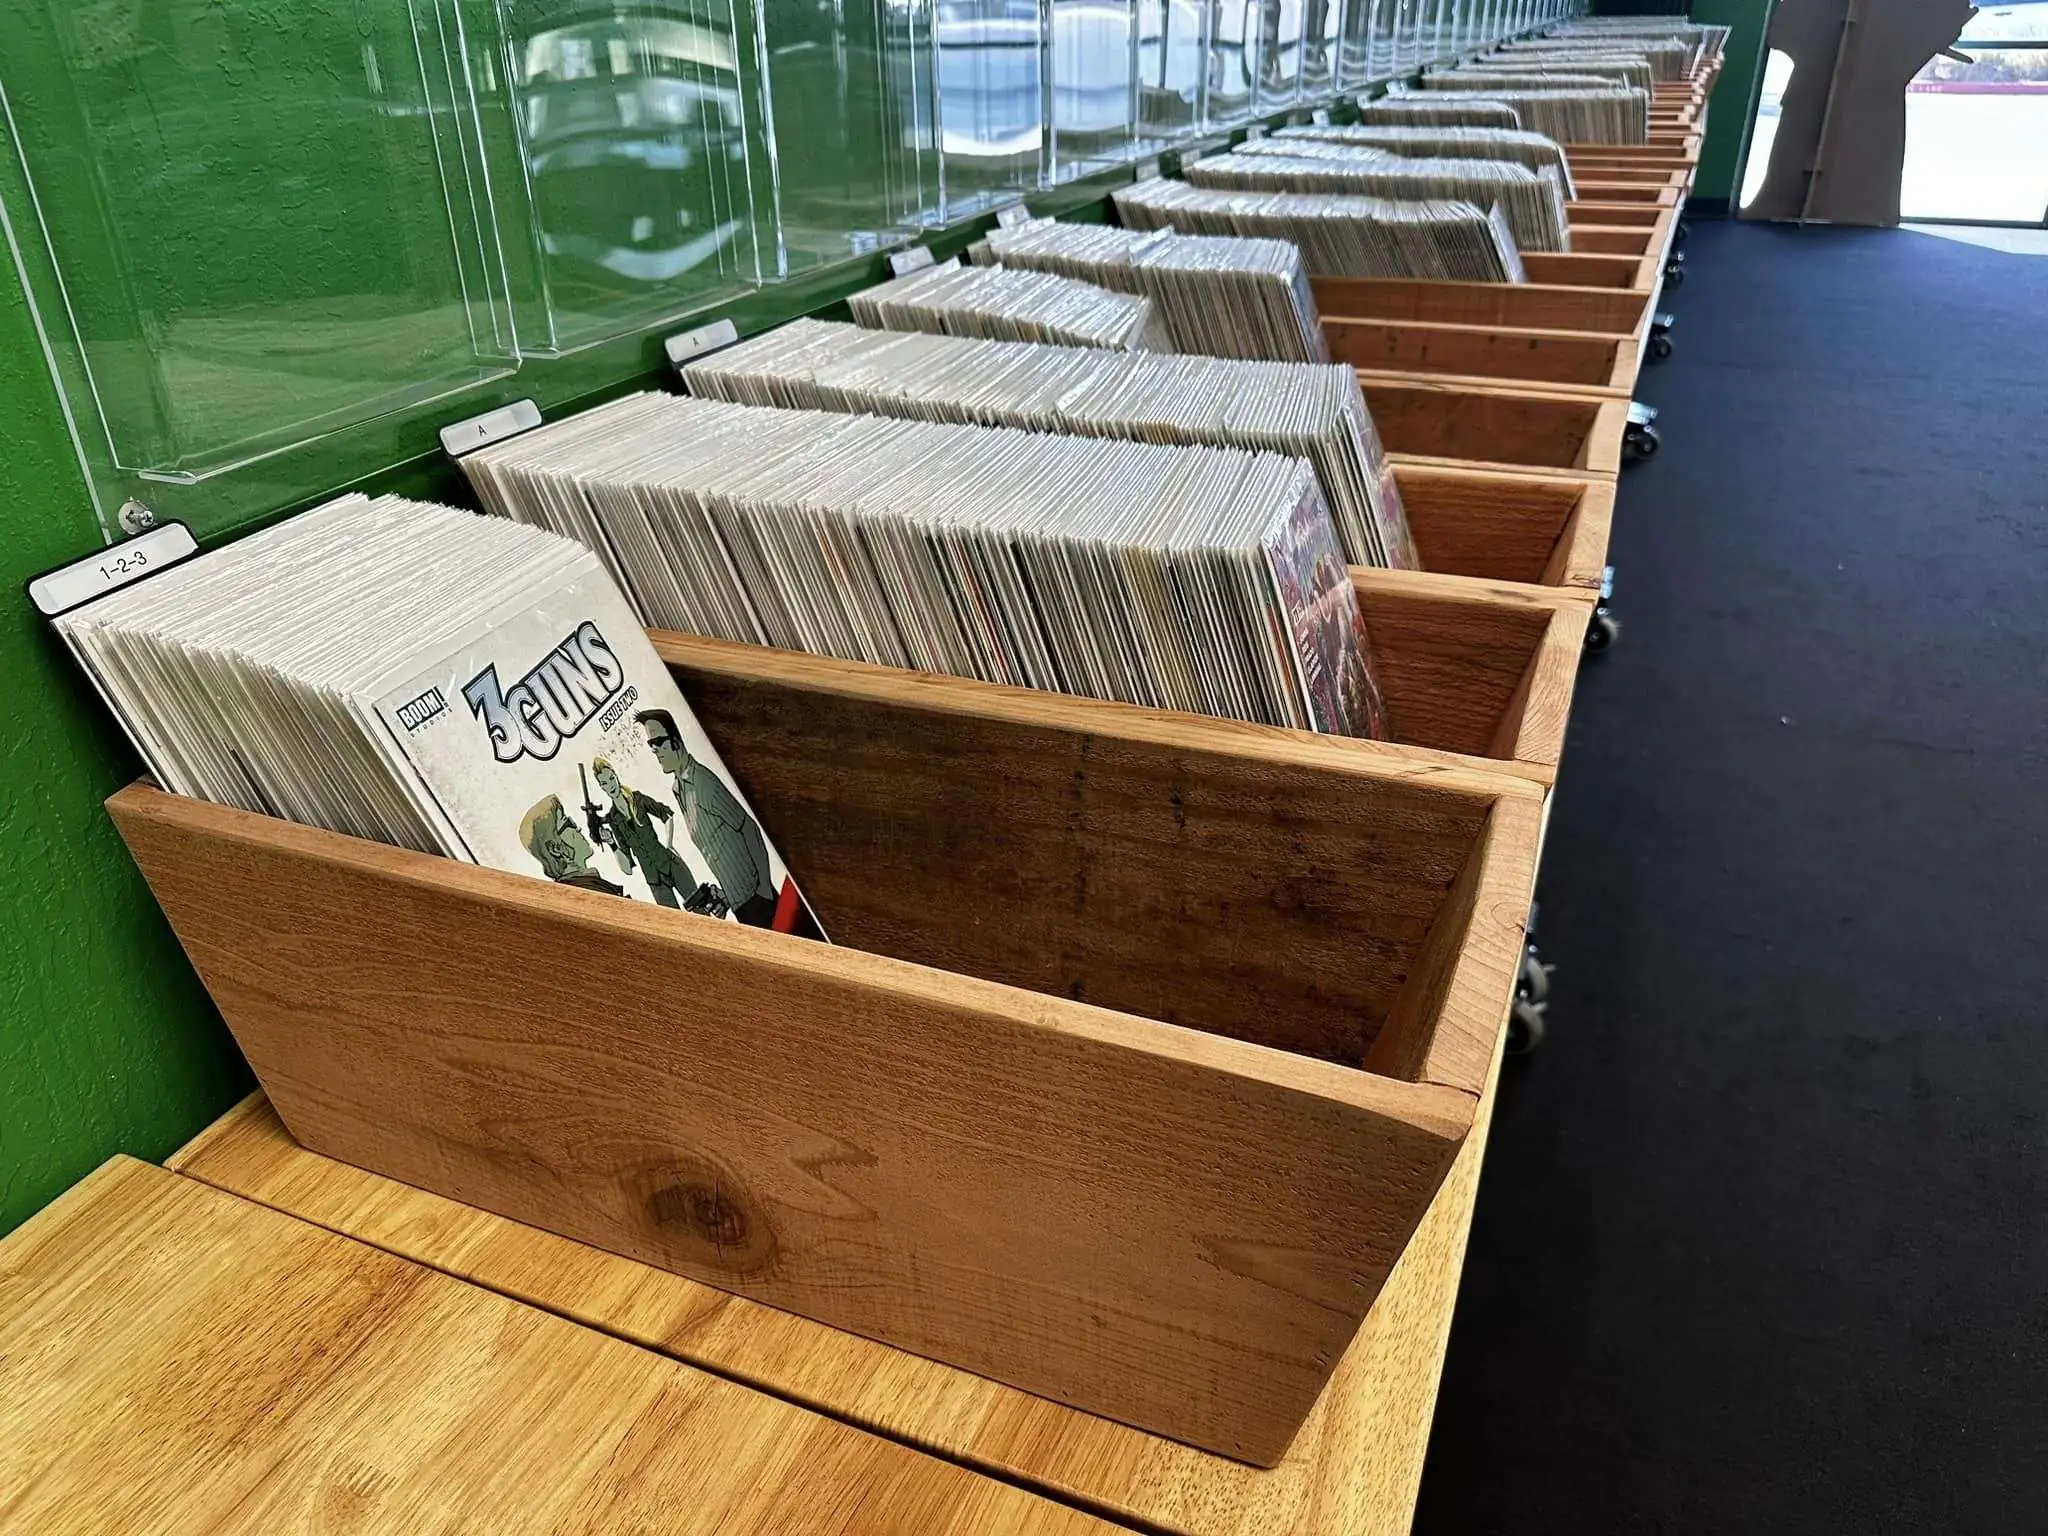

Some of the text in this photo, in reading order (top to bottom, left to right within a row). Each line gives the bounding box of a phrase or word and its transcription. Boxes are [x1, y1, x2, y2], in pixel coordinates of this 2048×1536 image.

[478, 424, 488, 437] A
[98, 551, 147, 580] 1-2-3
[396, 686, 449, 731] BOOM!
[598, 685, 639, 732] ISSUE TWO
